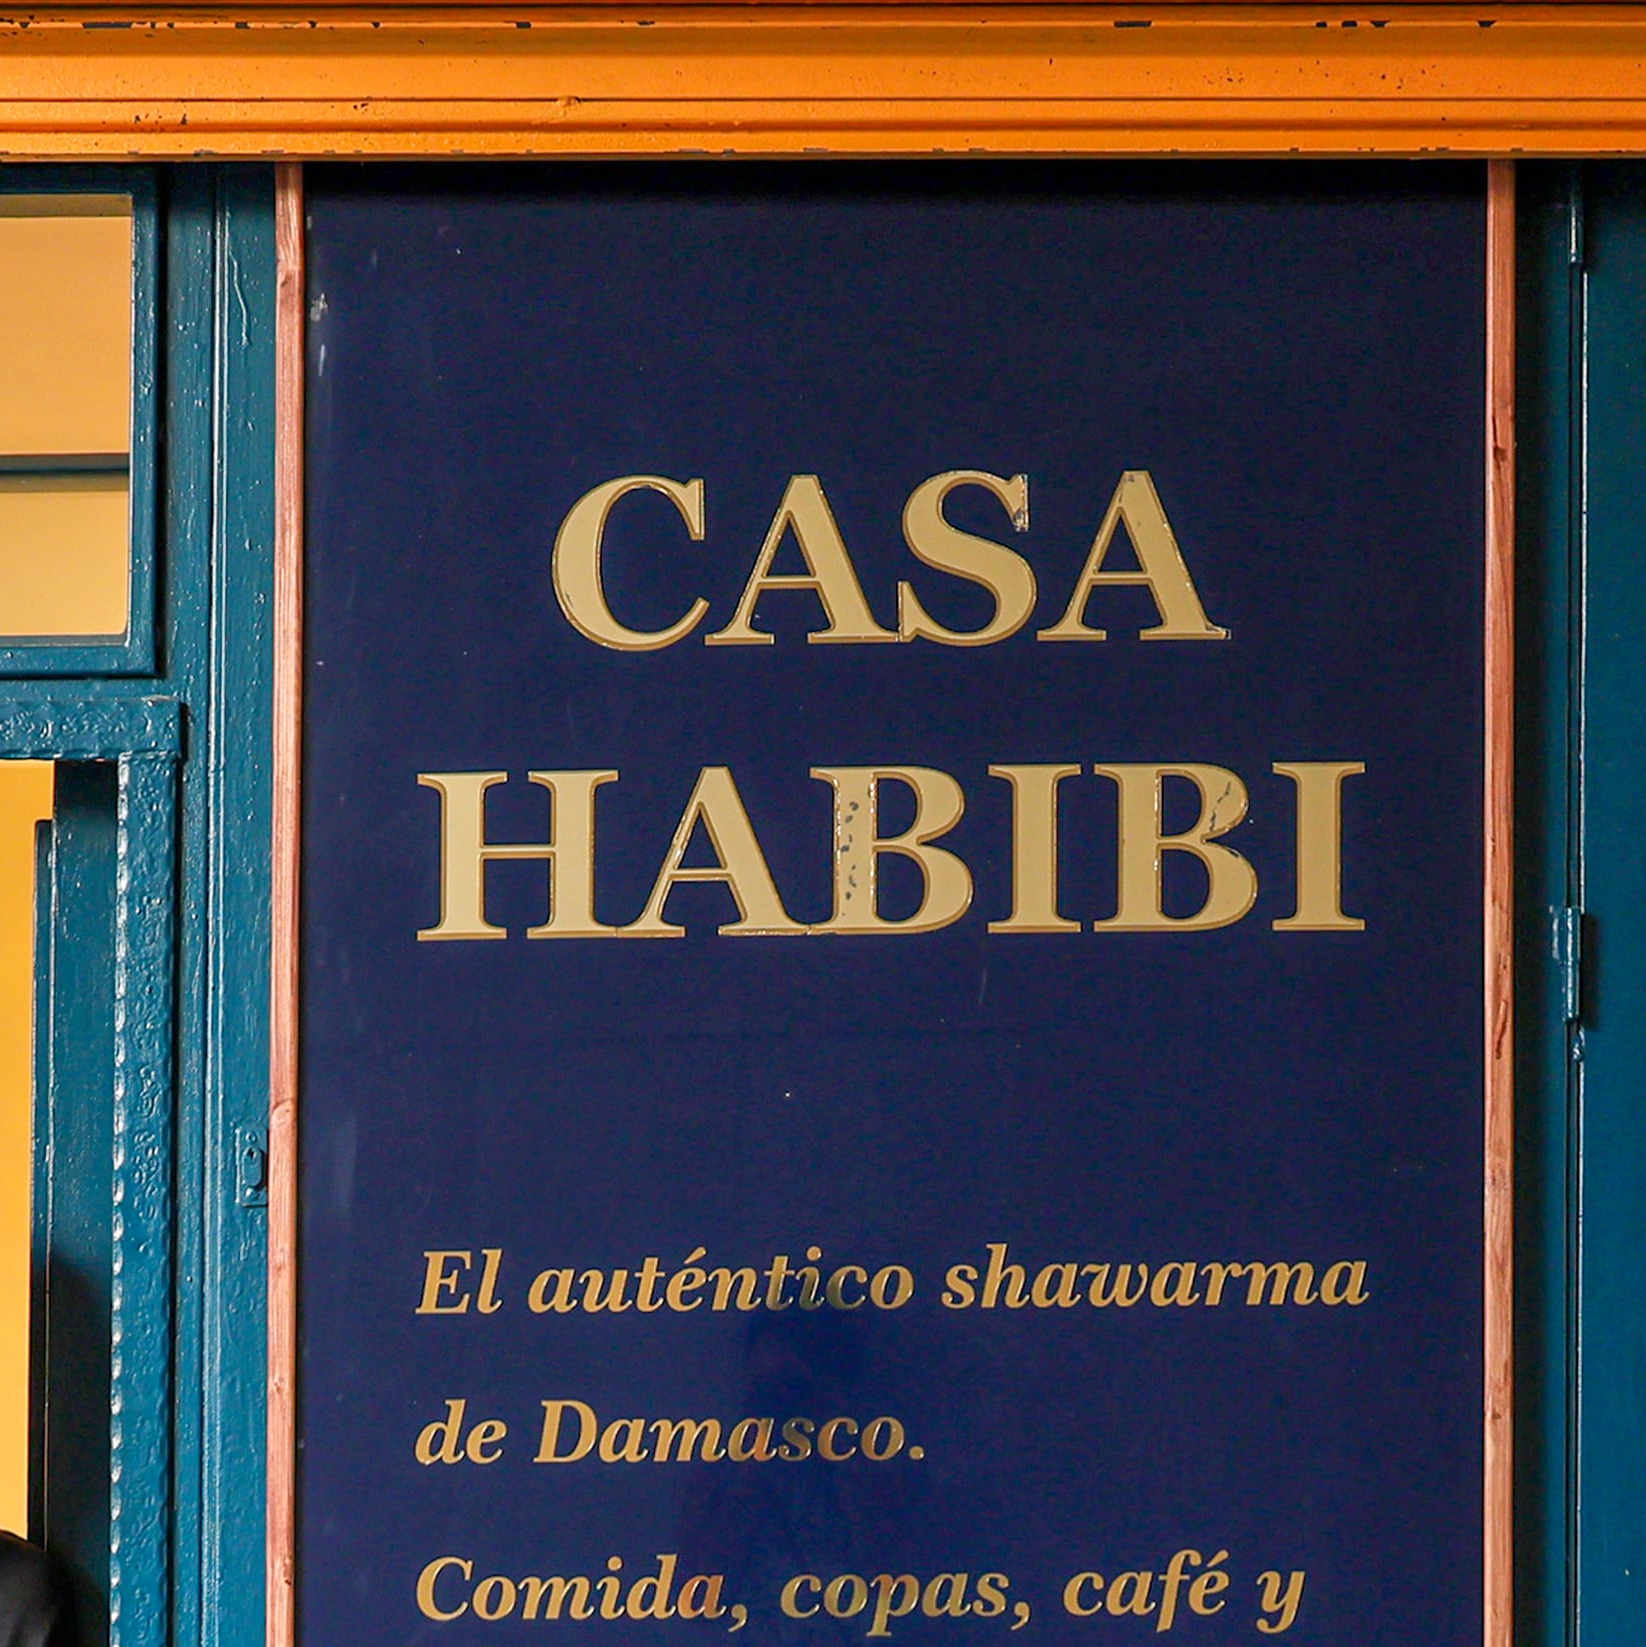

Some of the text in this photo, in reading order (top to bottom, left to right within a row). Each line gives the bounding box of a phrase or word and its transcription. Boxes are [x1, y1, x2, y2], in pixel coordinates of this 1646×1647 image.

[552, 470, 1231, 652] CASA
[417, 762, 1365, 942] HABIBI
[415, 1243, 1369, 1315] El auténtico shawarma
[414, 1399, 926, 1466] de Damasco.
[415, 1549, 1306, 1637] Comida, copas, café y
